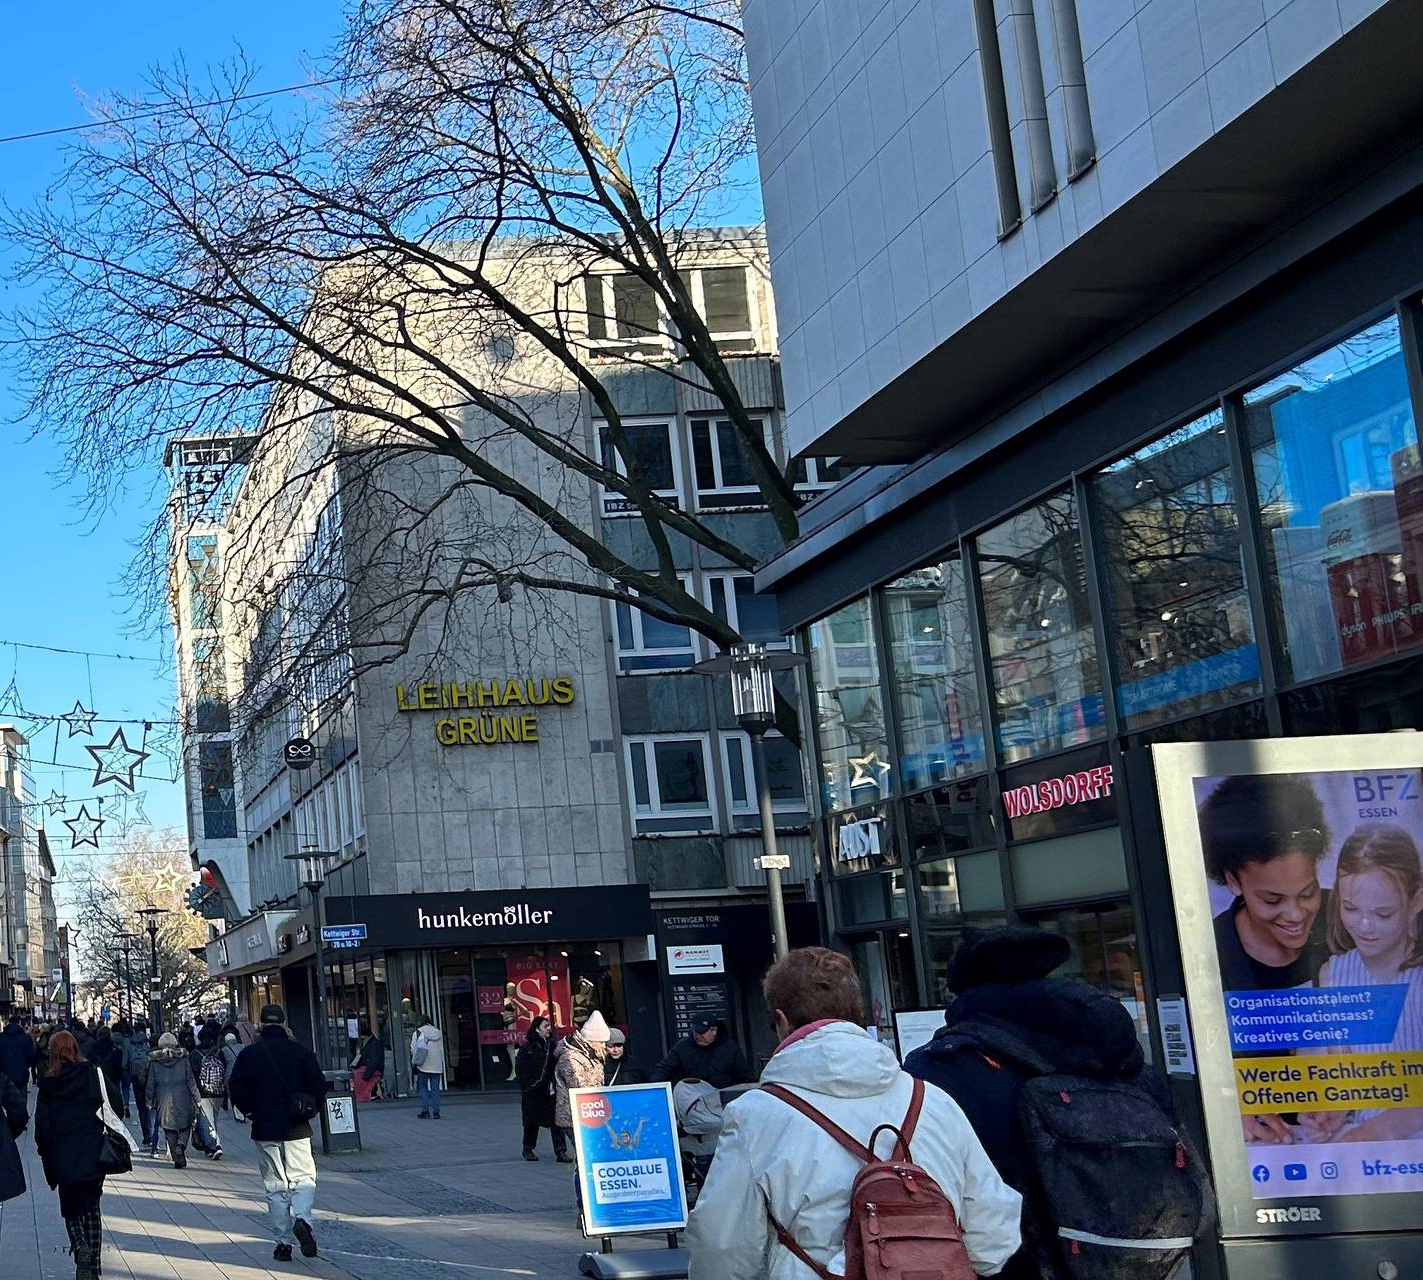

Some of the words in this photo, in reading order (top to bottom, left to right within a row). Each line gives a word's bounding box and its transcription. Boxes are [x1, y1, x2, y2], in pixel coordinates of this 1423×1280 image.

[395, 677, 576, 711] LEIHHAUS
[435, 709, 540, 746] GRÜNE
[1001, 764, 1114, 819] WOLSDORFF
[1352, 774, 1419, 802] BFZ
[1358, 807, 1399, 819] ESSEN
[417, 903, 553, 929] hunkemöller
[1228, 991, 1372, 1011] Organisationstalent?
[1231, 1009, 1375, 1027] Kommunikationsass?
[1233, 1030, 1300, 1044] Kreatives
[1302, 1027, 1350, 1041] Genie?
[1238, 1065, 1302, 1083] Werde
[1307, 1060, 1396, 1081] Fachkraft
[1242, 1089, 1319, 1105] Offenen
[1324, 1083, 1410, 1102] Ganztag!
[579, 1099, 605, 1110] cool
[581, 1109, 606, 1119] blue
[598, 1163, 663, 1179] COOLBLUE
[599, 1178, 642, 1191] ESSEN.
[1256, 1206, 1322, 1224] STRÖER
